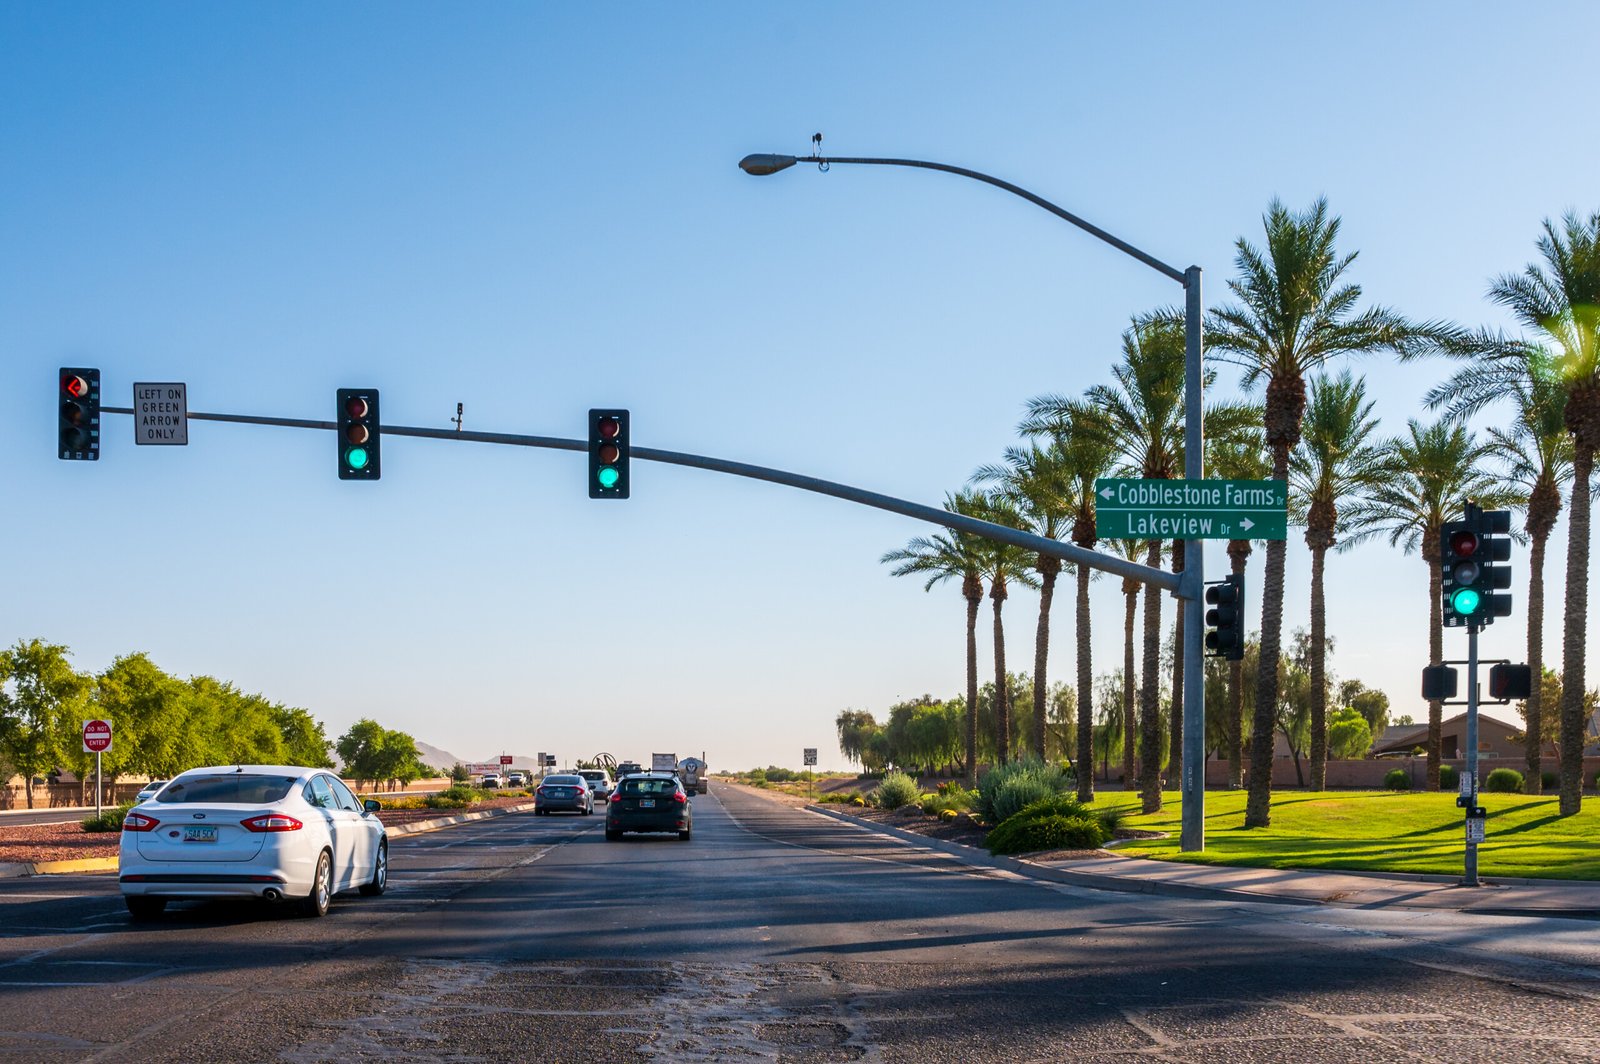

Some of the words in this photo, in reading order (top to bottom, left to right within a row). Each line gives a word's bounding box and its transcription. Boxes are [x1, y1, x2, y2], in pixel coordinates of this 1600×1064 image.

[139, 389, 162, 400] LEFT
[168, 389, 181, 400] ON
[142, 402, 179, 413] GREEN
[143, 416, 180, 426] ARROW
[148, 429, 175, 439] ONLY
[1118, 483, 1220, 505] Cobblestone
[1225, 484, 1274, 506] Farms
[1276, 496, 1285, 506] Dr
[1128, 513, 1213, 534] Lakeview
[1220, 523, 1231, 535] Dr
